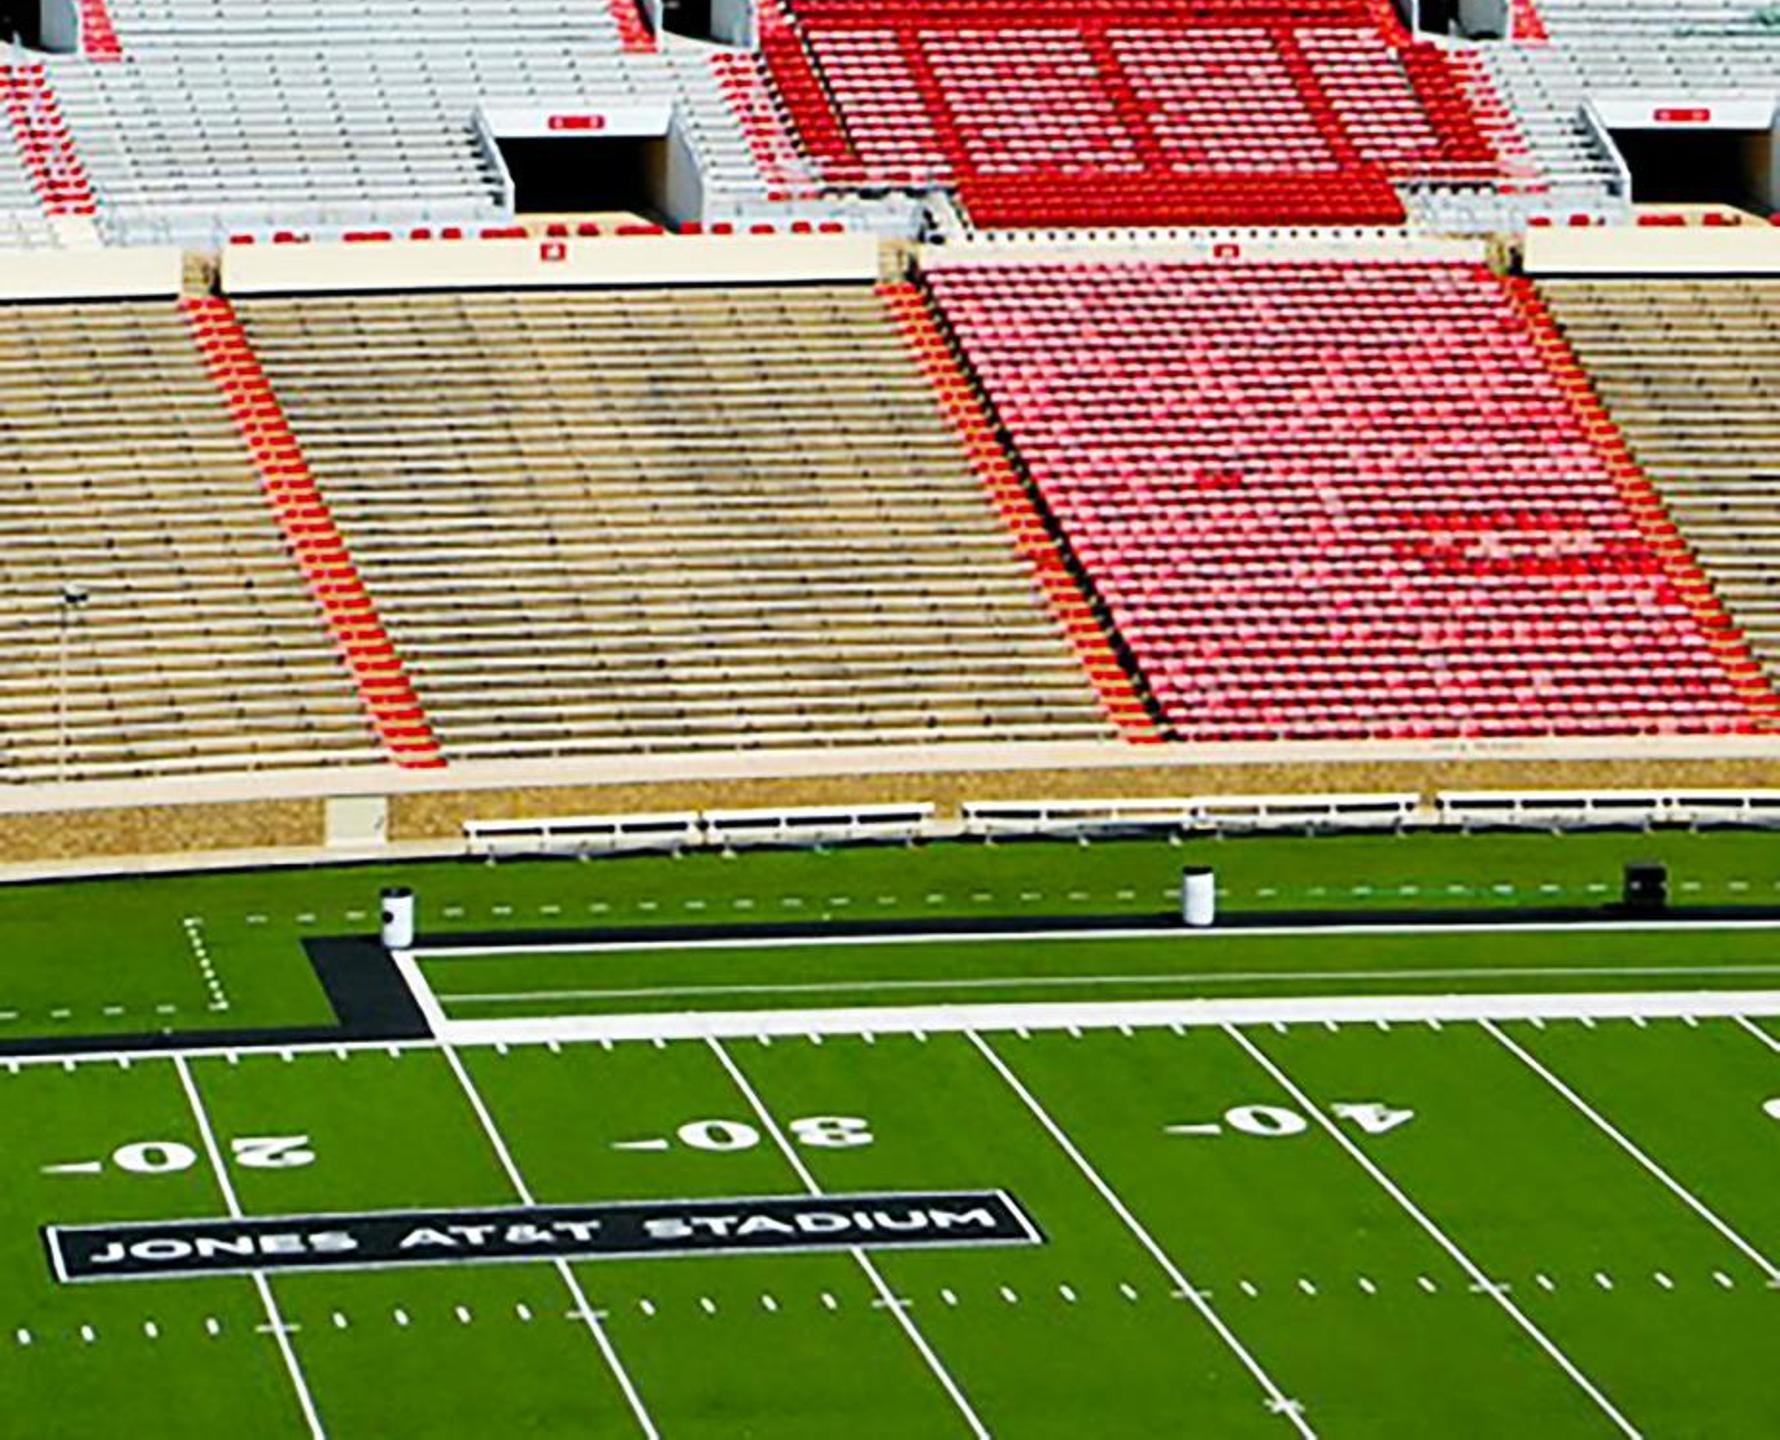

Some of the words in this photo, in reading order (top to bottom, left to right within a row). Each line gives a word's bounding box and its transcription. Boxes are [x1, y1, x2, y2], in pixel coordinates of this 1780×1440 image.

[91, 1231, 358, 1263] JONES
[400, 1219, 601, 1249] AT&T
[643, 1208, 996, 1239] STADIUM
